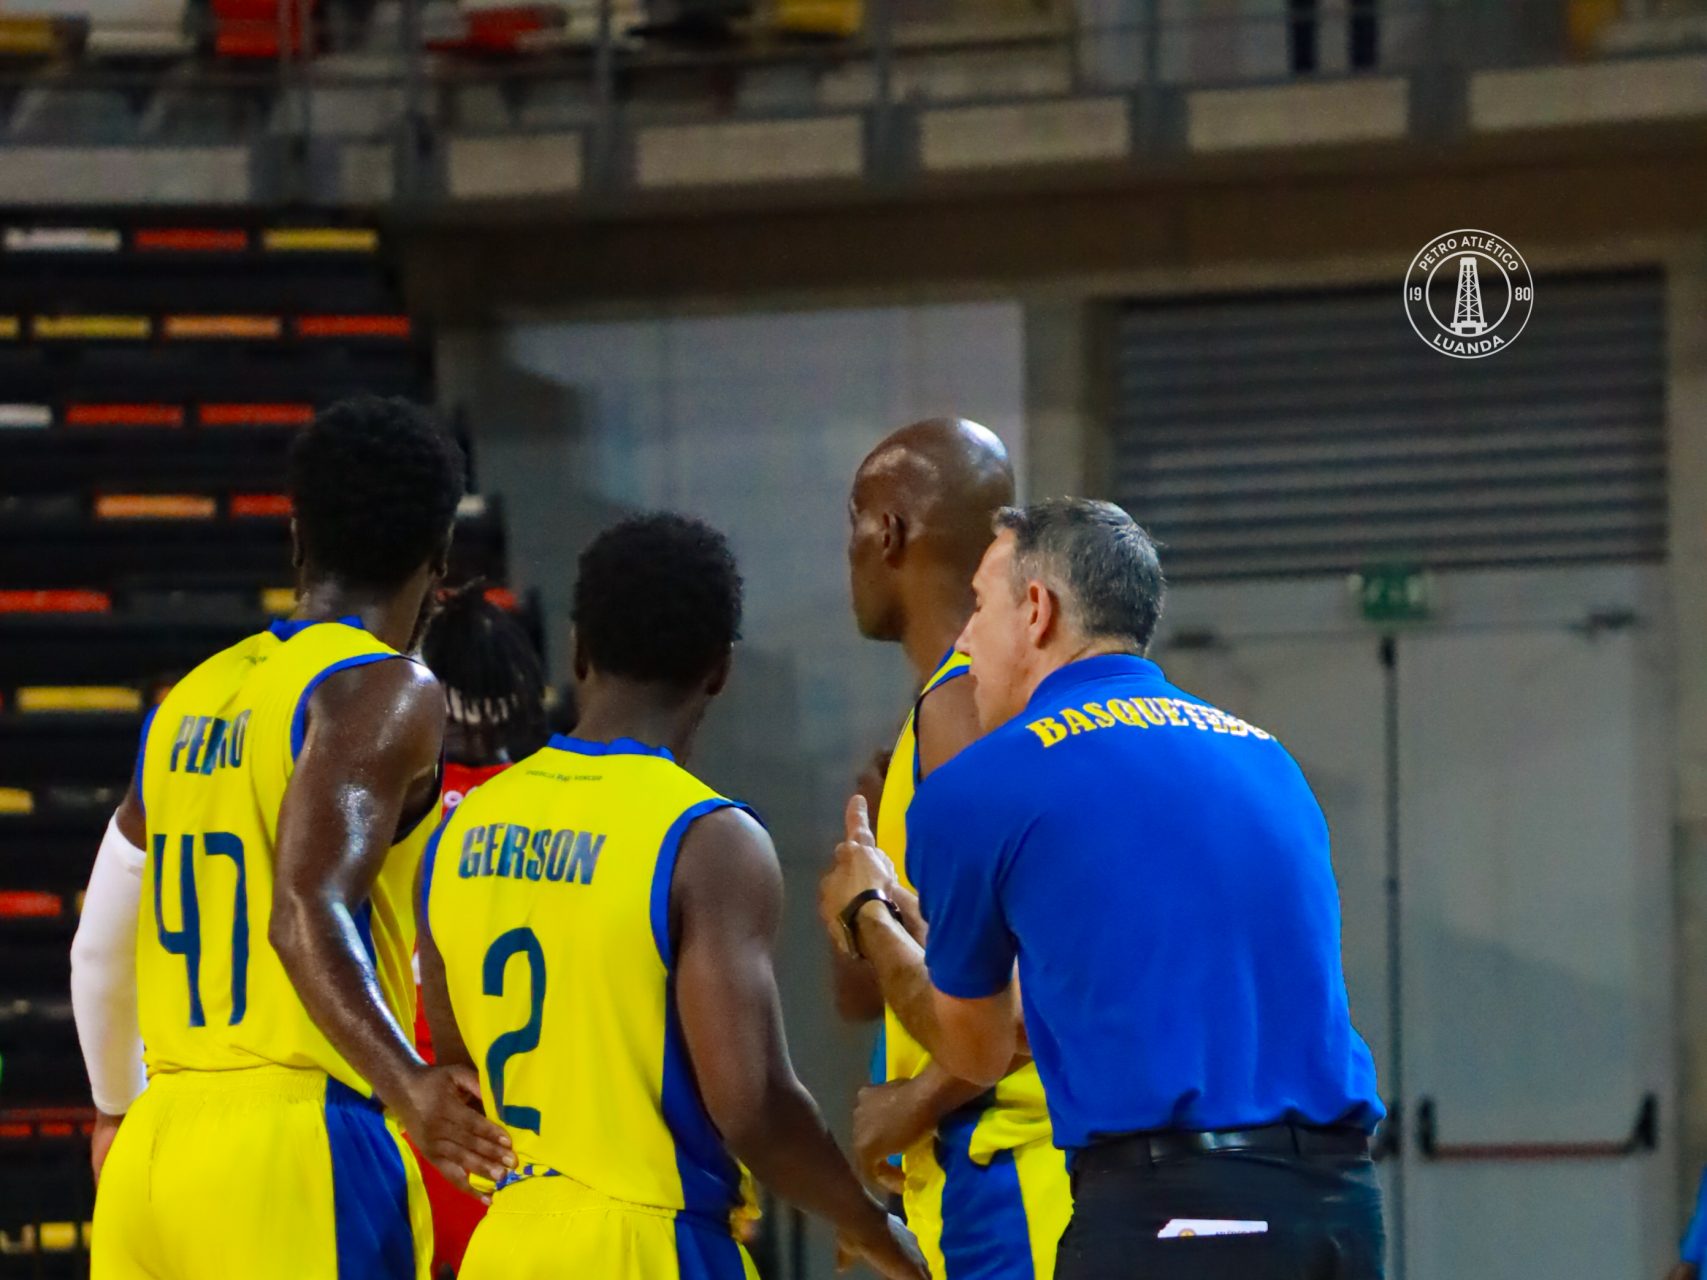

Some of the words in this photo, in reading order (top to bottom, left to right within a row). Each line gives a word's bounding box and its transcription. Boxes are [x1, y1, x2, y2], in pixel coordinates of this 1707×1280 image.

[153, 831, 249, 1027] 47
[458, 822, 607, 885] GERSON
[482, 926, 547, 1136] 2
